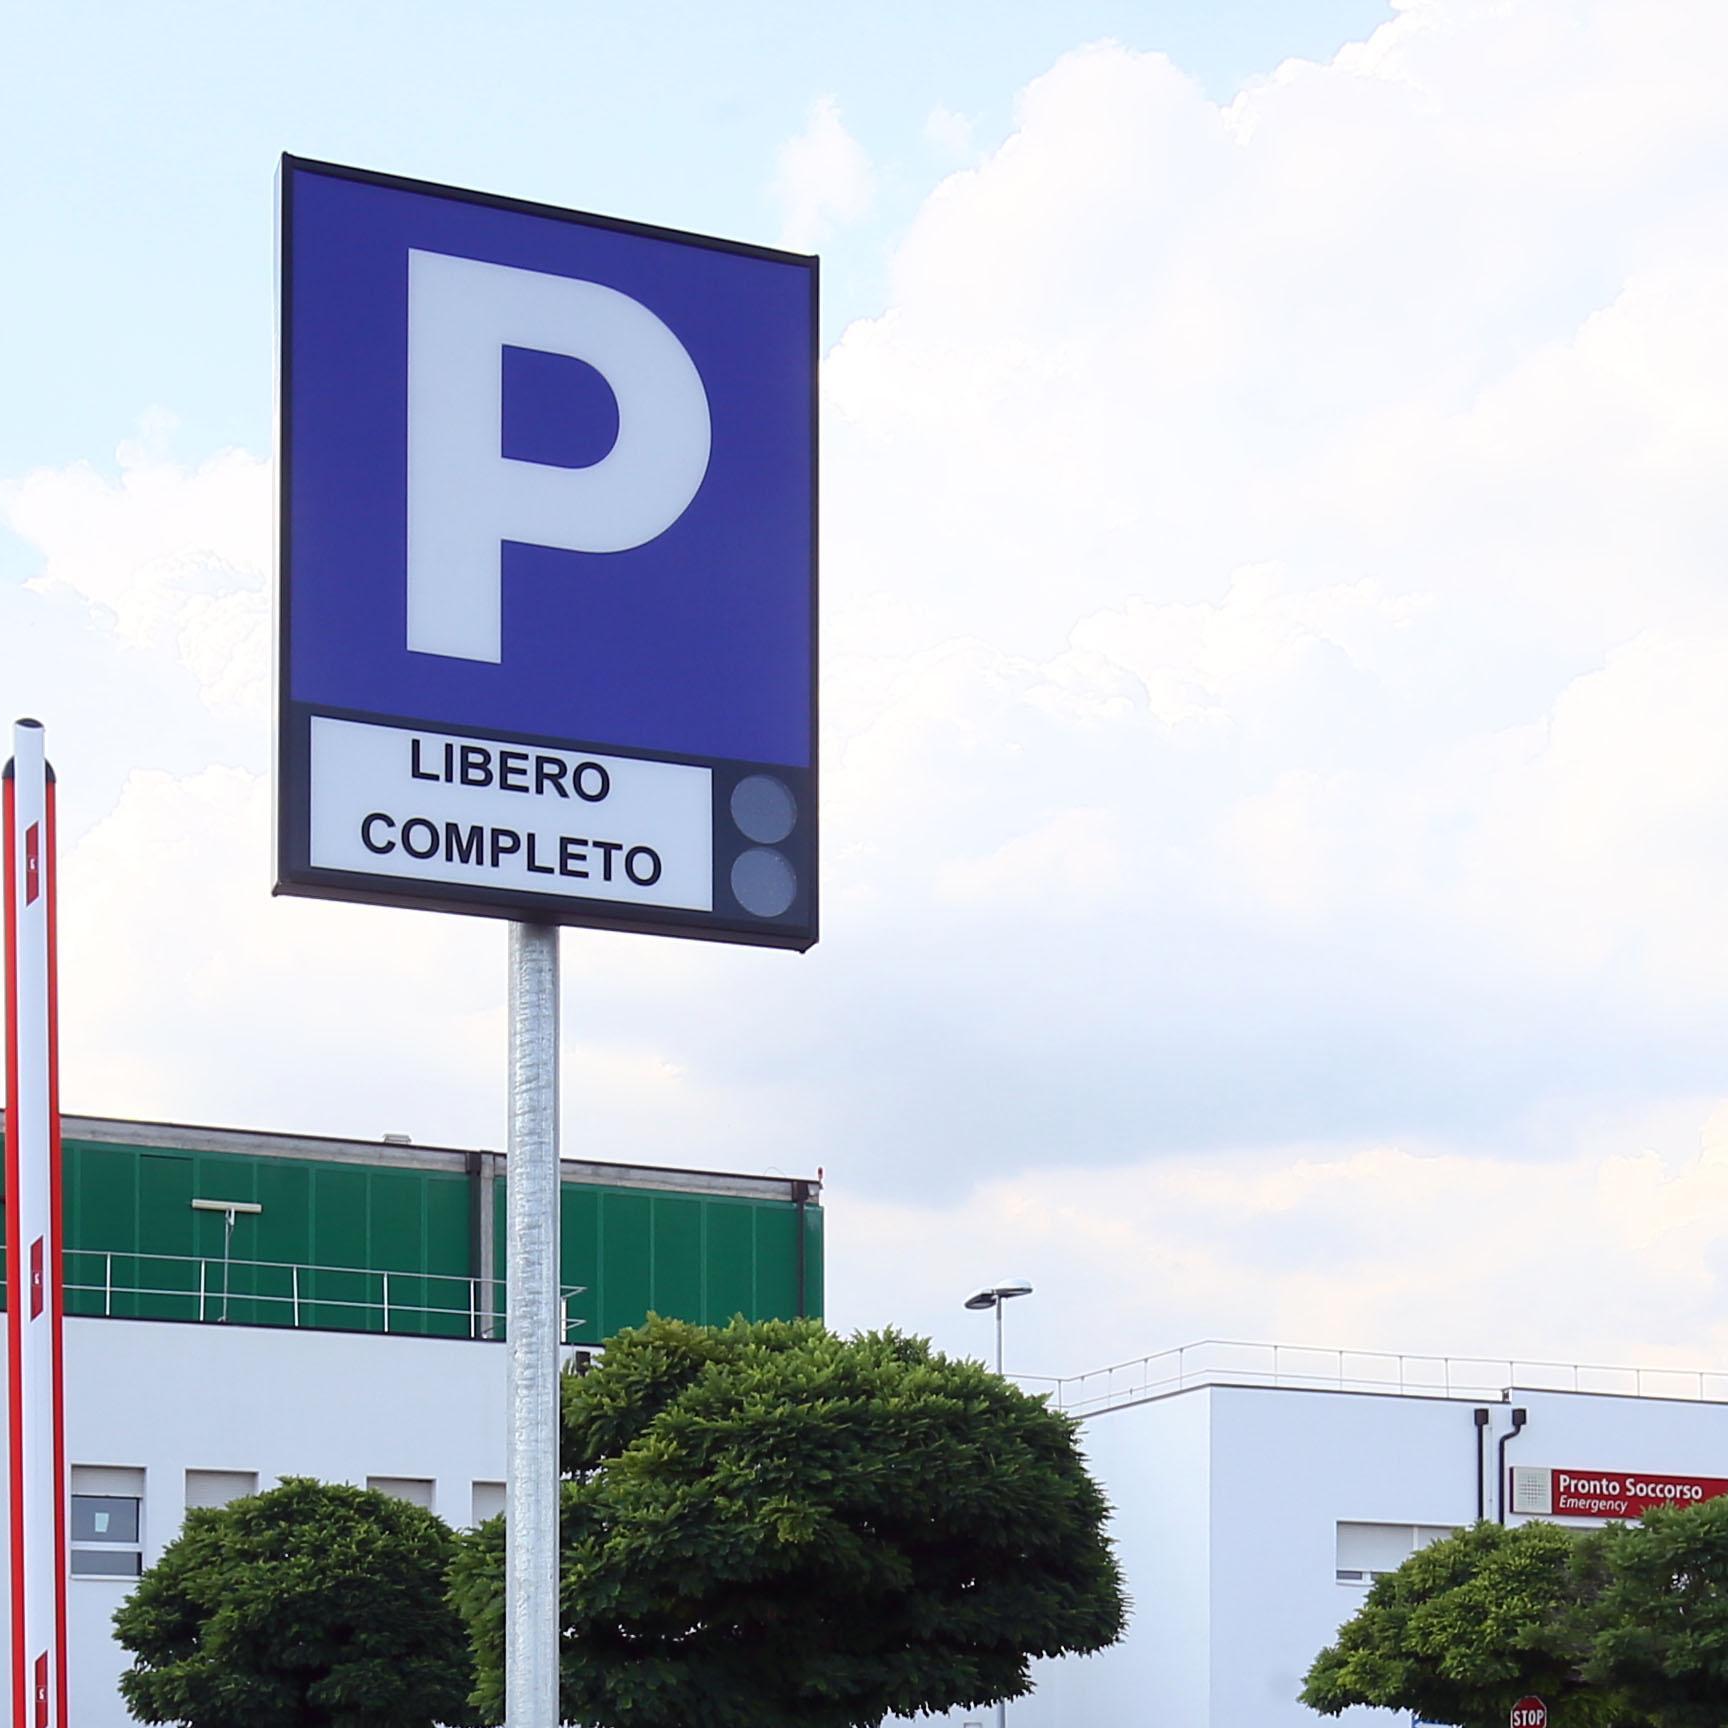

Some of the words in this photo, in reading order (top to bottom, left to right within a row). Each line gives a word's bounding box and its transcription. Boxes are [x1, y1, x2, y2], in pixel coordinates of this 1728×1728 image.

[406, 247, 712, 665] P
[410, 738, 611, 803] LIBERO
[361, 811, 663, 887] COMPLETO
[1558, 1473, 1620, 1496] Pronto
[1625, 1478, 1703, 1500] Soccorso
[1558, 1495, 1628, 1514] Emergency
[1513, 1709, 1544, 1727] STOP
